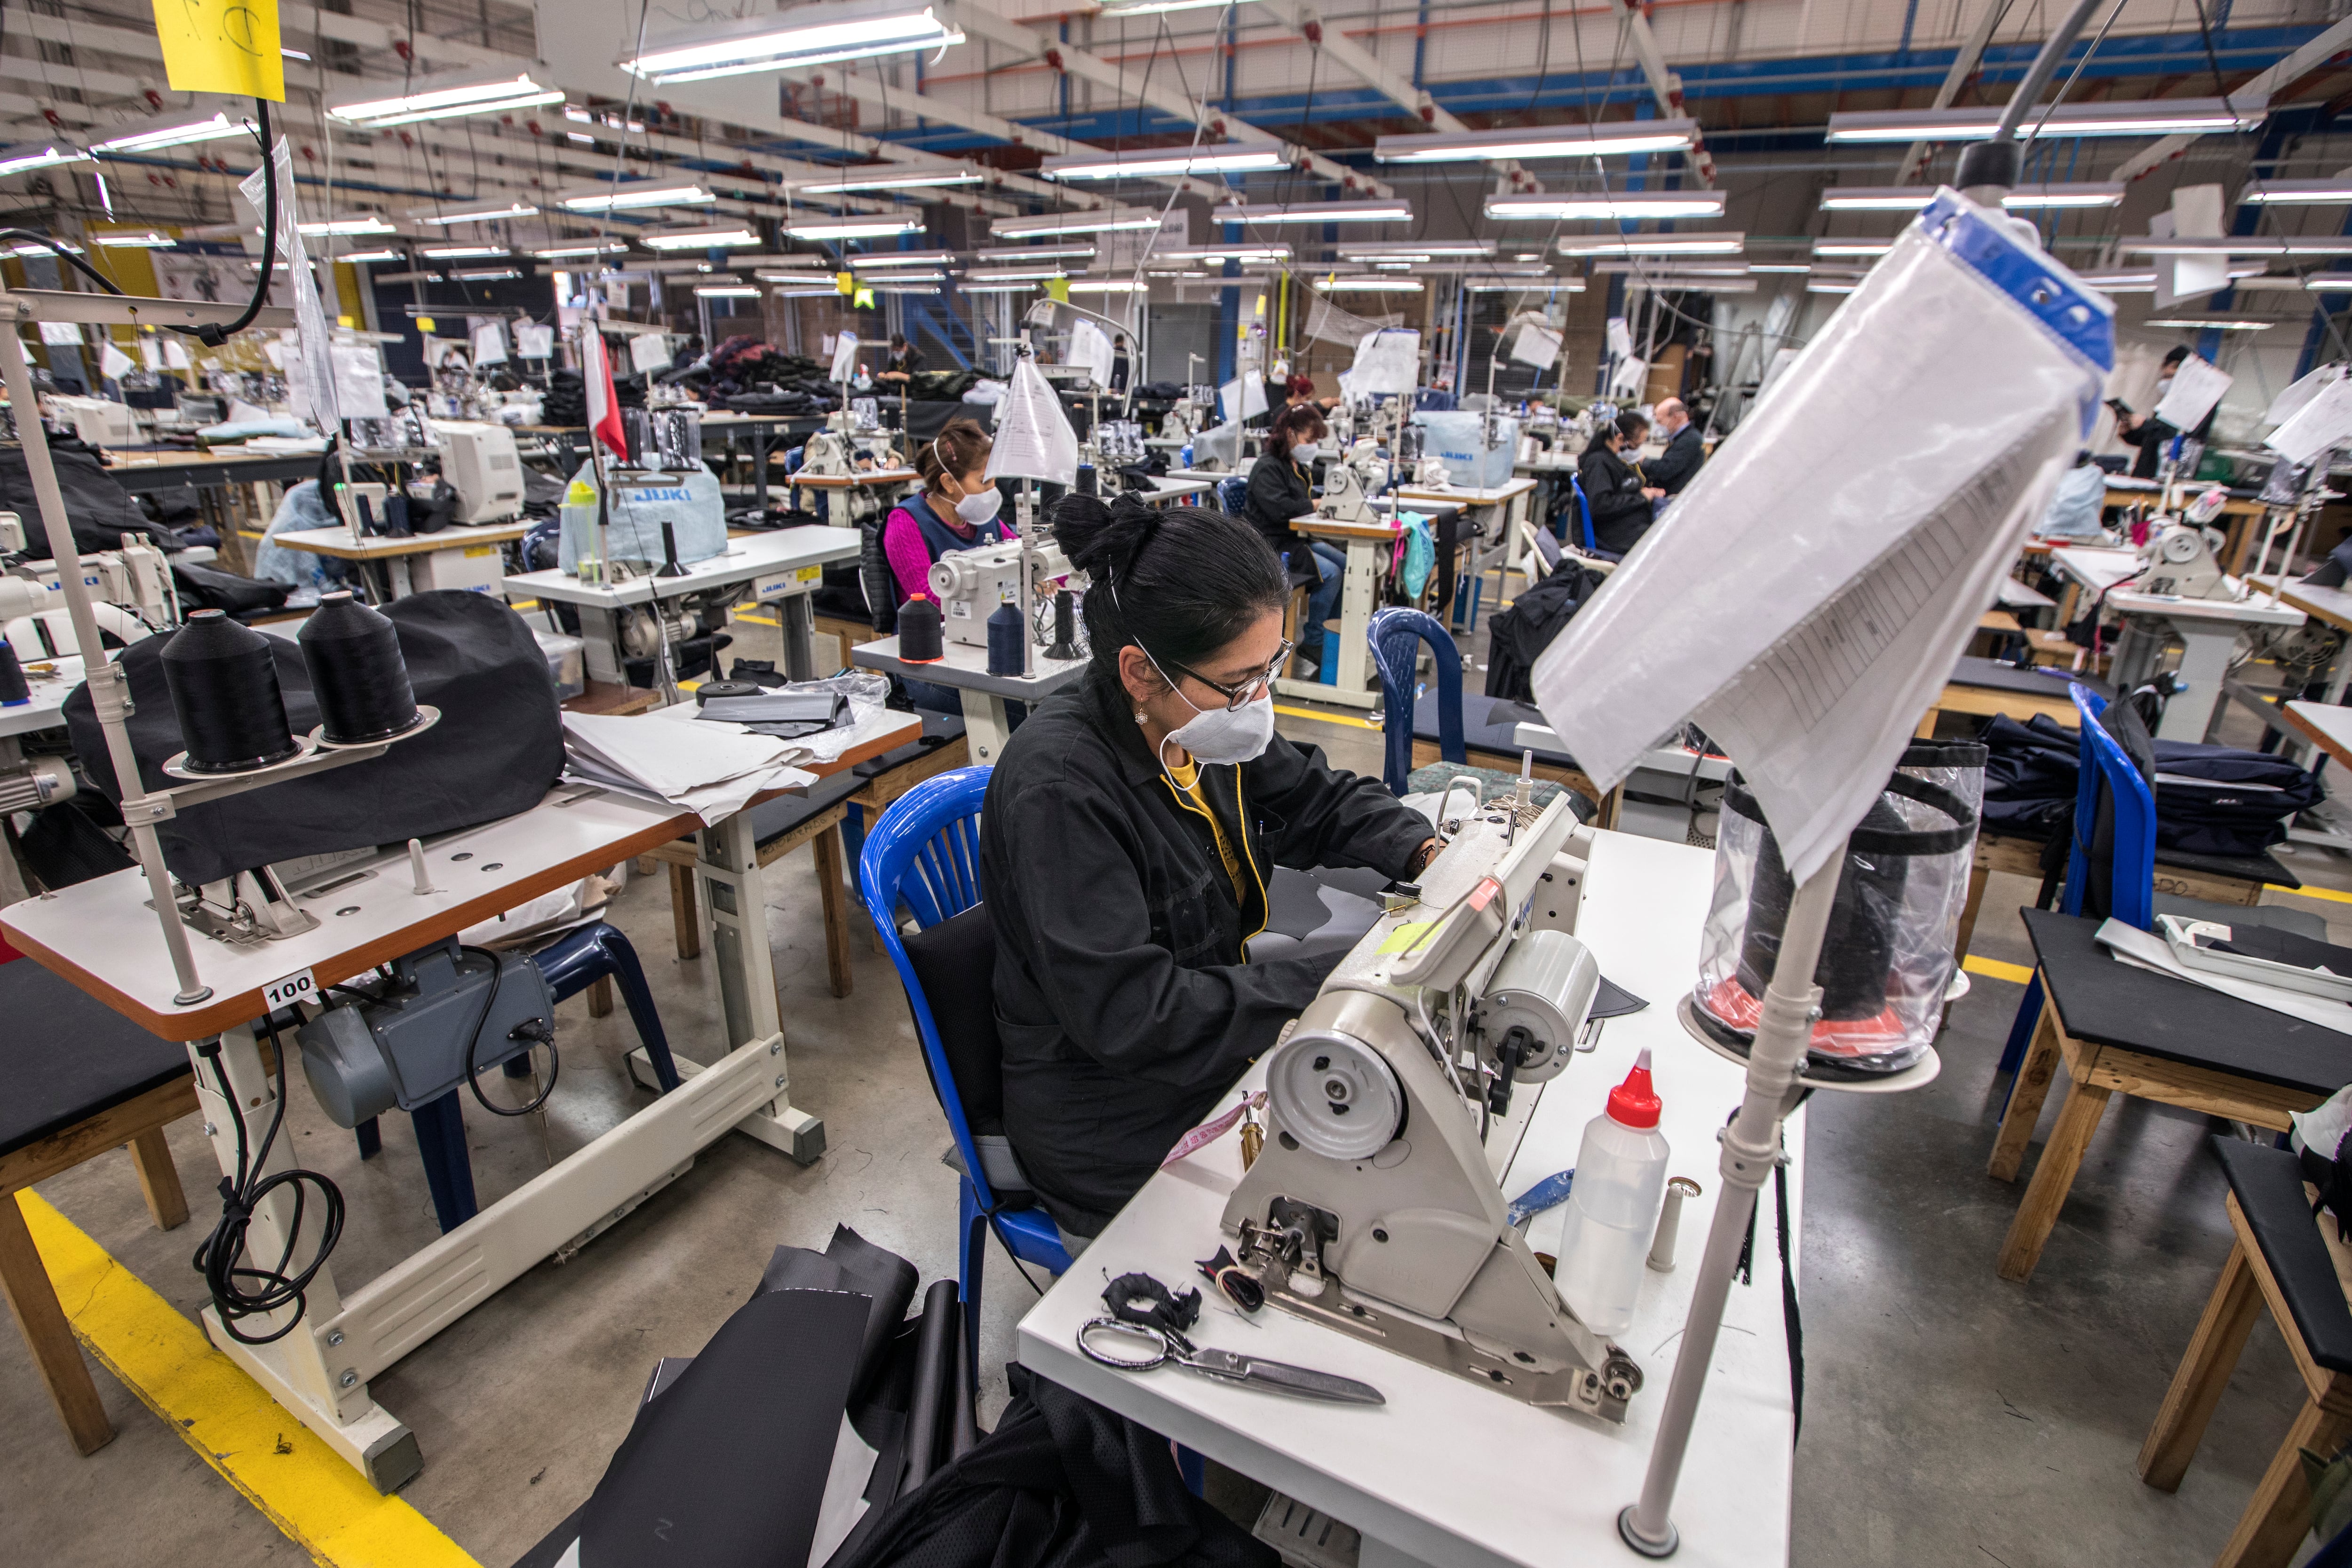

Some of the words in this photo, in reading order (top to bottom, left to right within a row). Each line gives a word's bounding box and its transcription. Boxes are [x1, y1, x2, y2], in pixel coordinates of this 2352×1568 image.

[1440, 451, 1473, 460] JUKI
[635, 488, 691, 501] JUKI
[46, 576, 99, 591] JKI
[762, 582, 786, 593] JUKI
[269, 977, 310, 1003] 100
